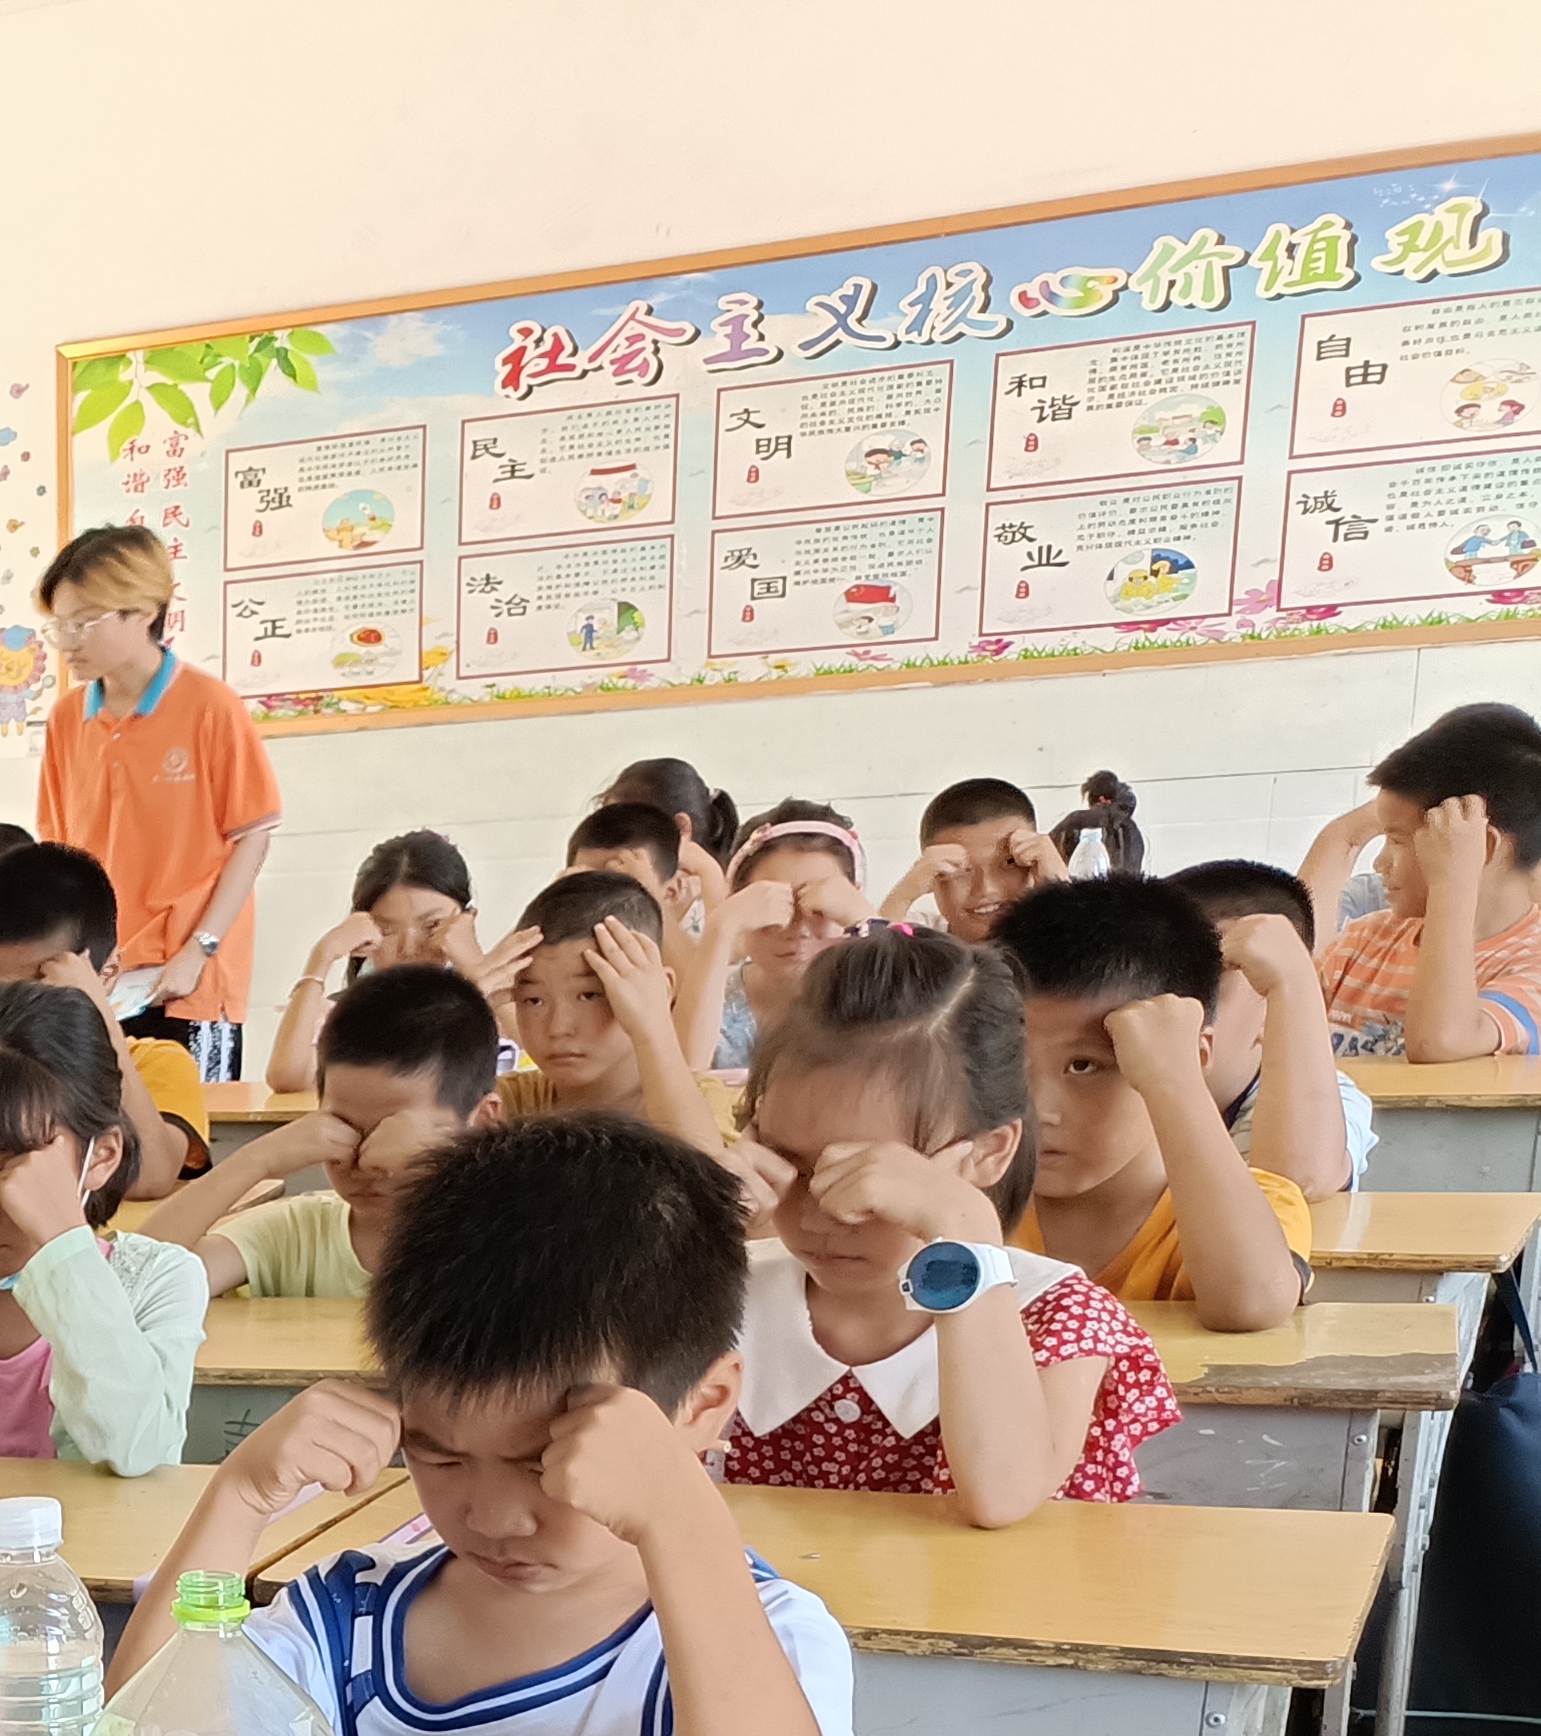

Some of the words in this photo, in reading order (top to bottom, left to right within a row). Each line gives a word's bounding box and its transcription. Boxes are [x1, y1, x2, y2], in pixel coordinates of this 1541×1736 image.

[498, 199, 1500, 394] 社会主义核心价值观
[1314, 334, 1389, 388] 自由
[1005, 373, 1082, 423] 和谐
[163, 430, 190, 489] 富强
[469, 437, 536, 484] 民主
[724, 408, 794, 461] 文明
[122, 438, 151, 494] 和谐
[234, 466, 295, 513] 富强
[163, 505, 190, 560] 民主
[1296, 490, 1380, 544] 诚信
[992, 521, 1070, 571] 敬业
[464, 574, 532, 618] 法治
[719, 547, 789, 601] 爱国
[230, 598, 293, 642] 公正
